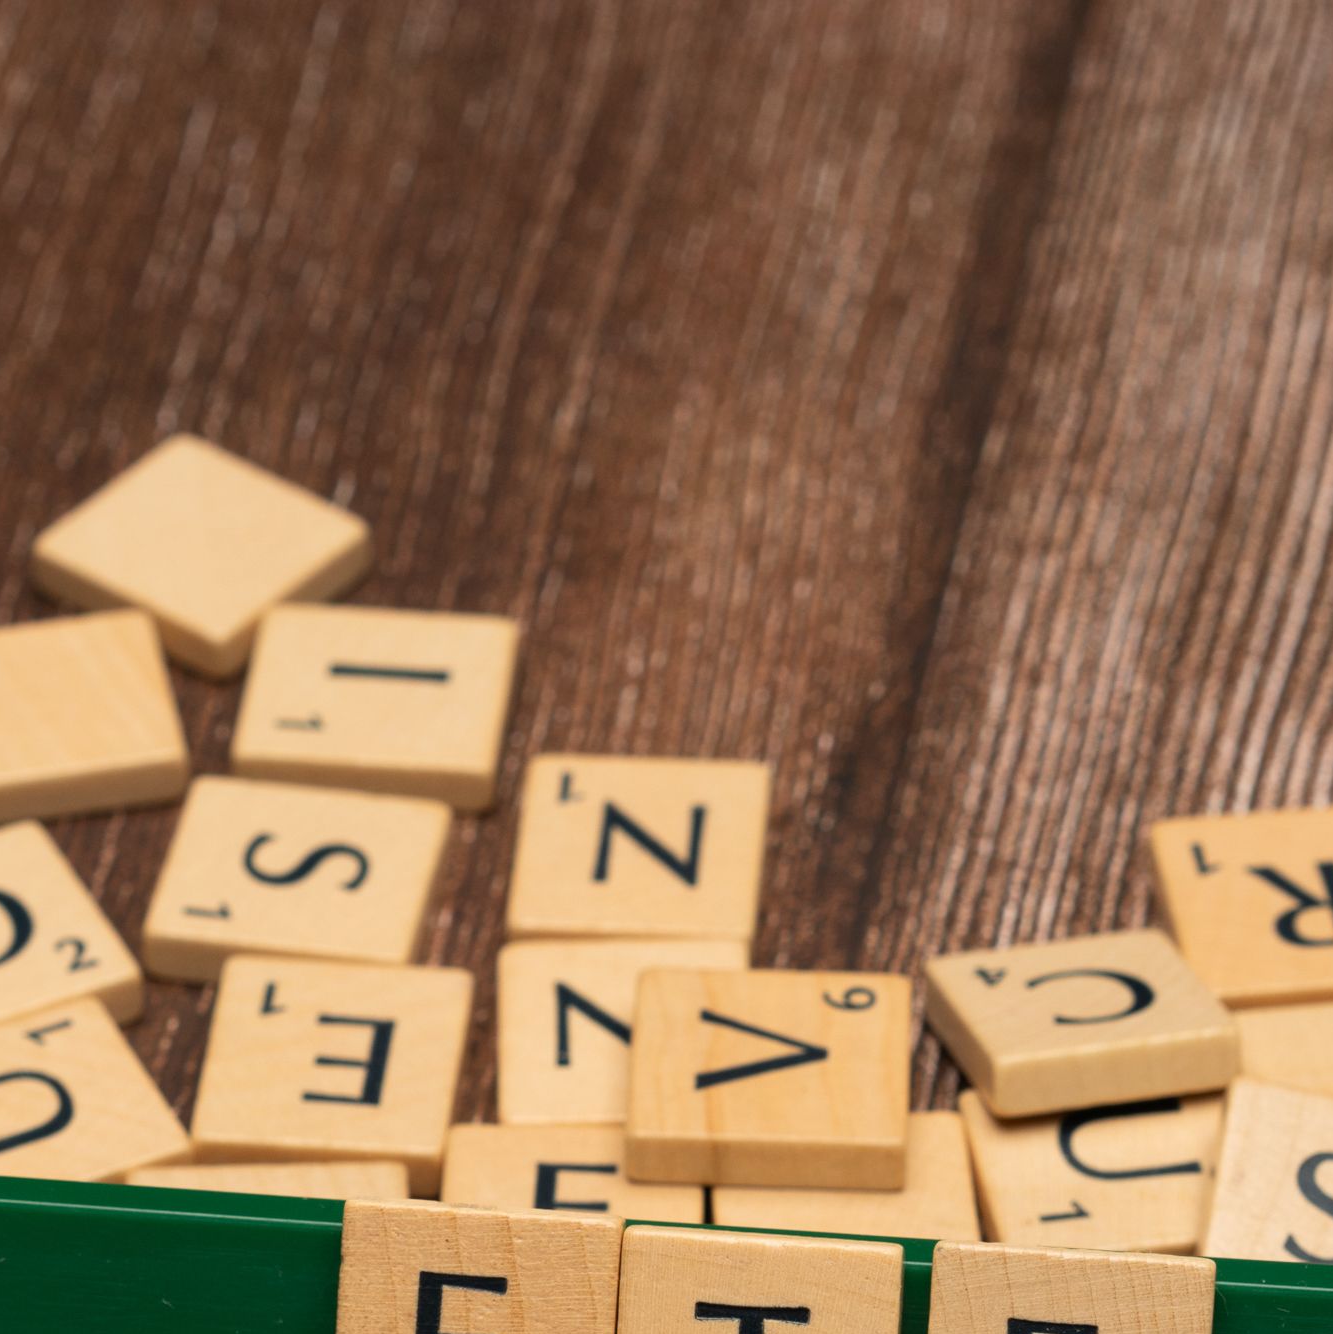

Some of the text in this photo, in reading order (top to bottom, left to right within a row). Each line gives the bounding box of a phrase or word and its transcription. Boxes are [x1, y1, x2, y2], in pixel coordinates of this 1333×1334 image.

[245, 836, 368, 889] S
[594, 804, 705, 885] N
[1029, 972, 1154, 1023] C
[304, 1016, 394, 1105] E
[696, 1011, 827, 1089] V
[1057, 1099, 1202, 1181] U
